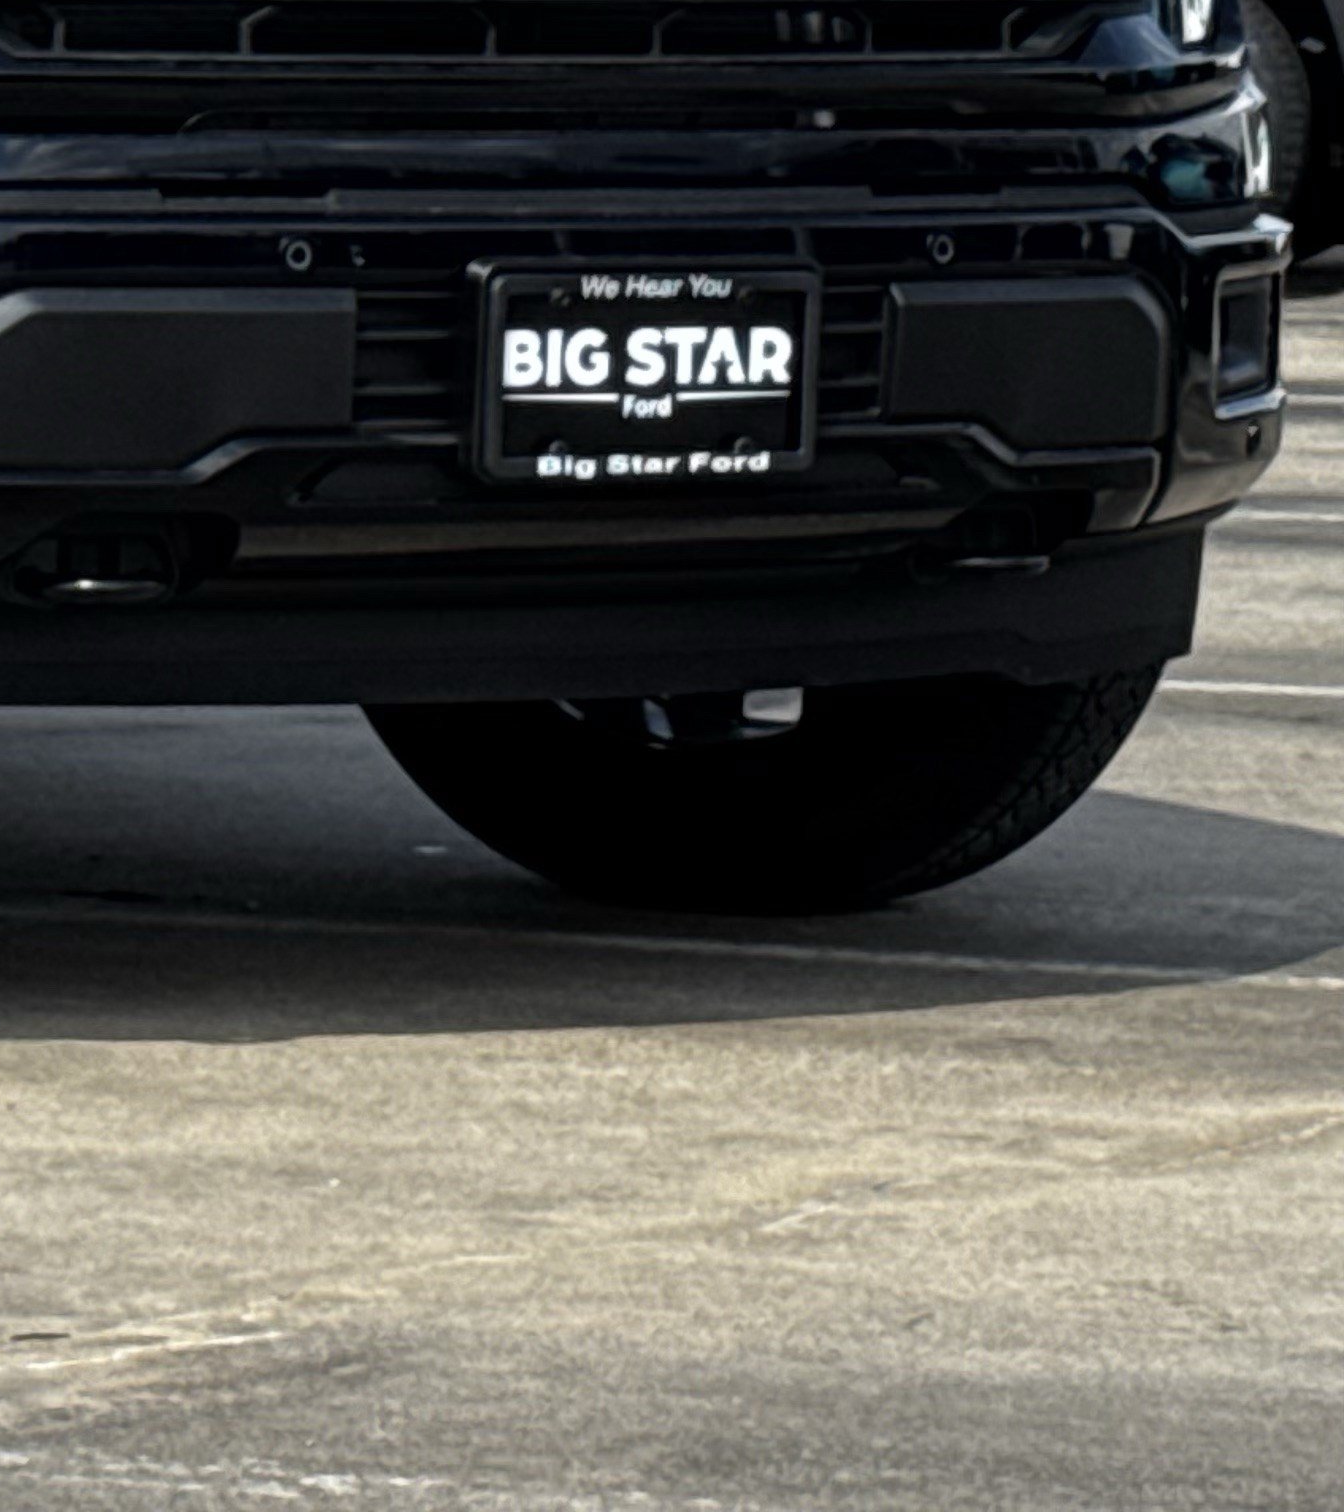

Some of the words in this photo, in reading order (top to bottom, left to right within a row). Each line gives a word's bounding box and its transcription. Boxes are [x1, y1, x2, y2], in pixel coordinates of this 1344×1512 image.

[581, 274, 620, 299] We
[625, 275, 683, 298] Hear
[688, 273, 733, 298] You
[502, 328, 611, 387] BIG
[625, 326, 792, 385] STAR
[622, 394, 672, 418] Ford
[536, 455, 597, 480] Big
[607, 454, 681, 475] Star
[688, 451, 770, 474] Ford
